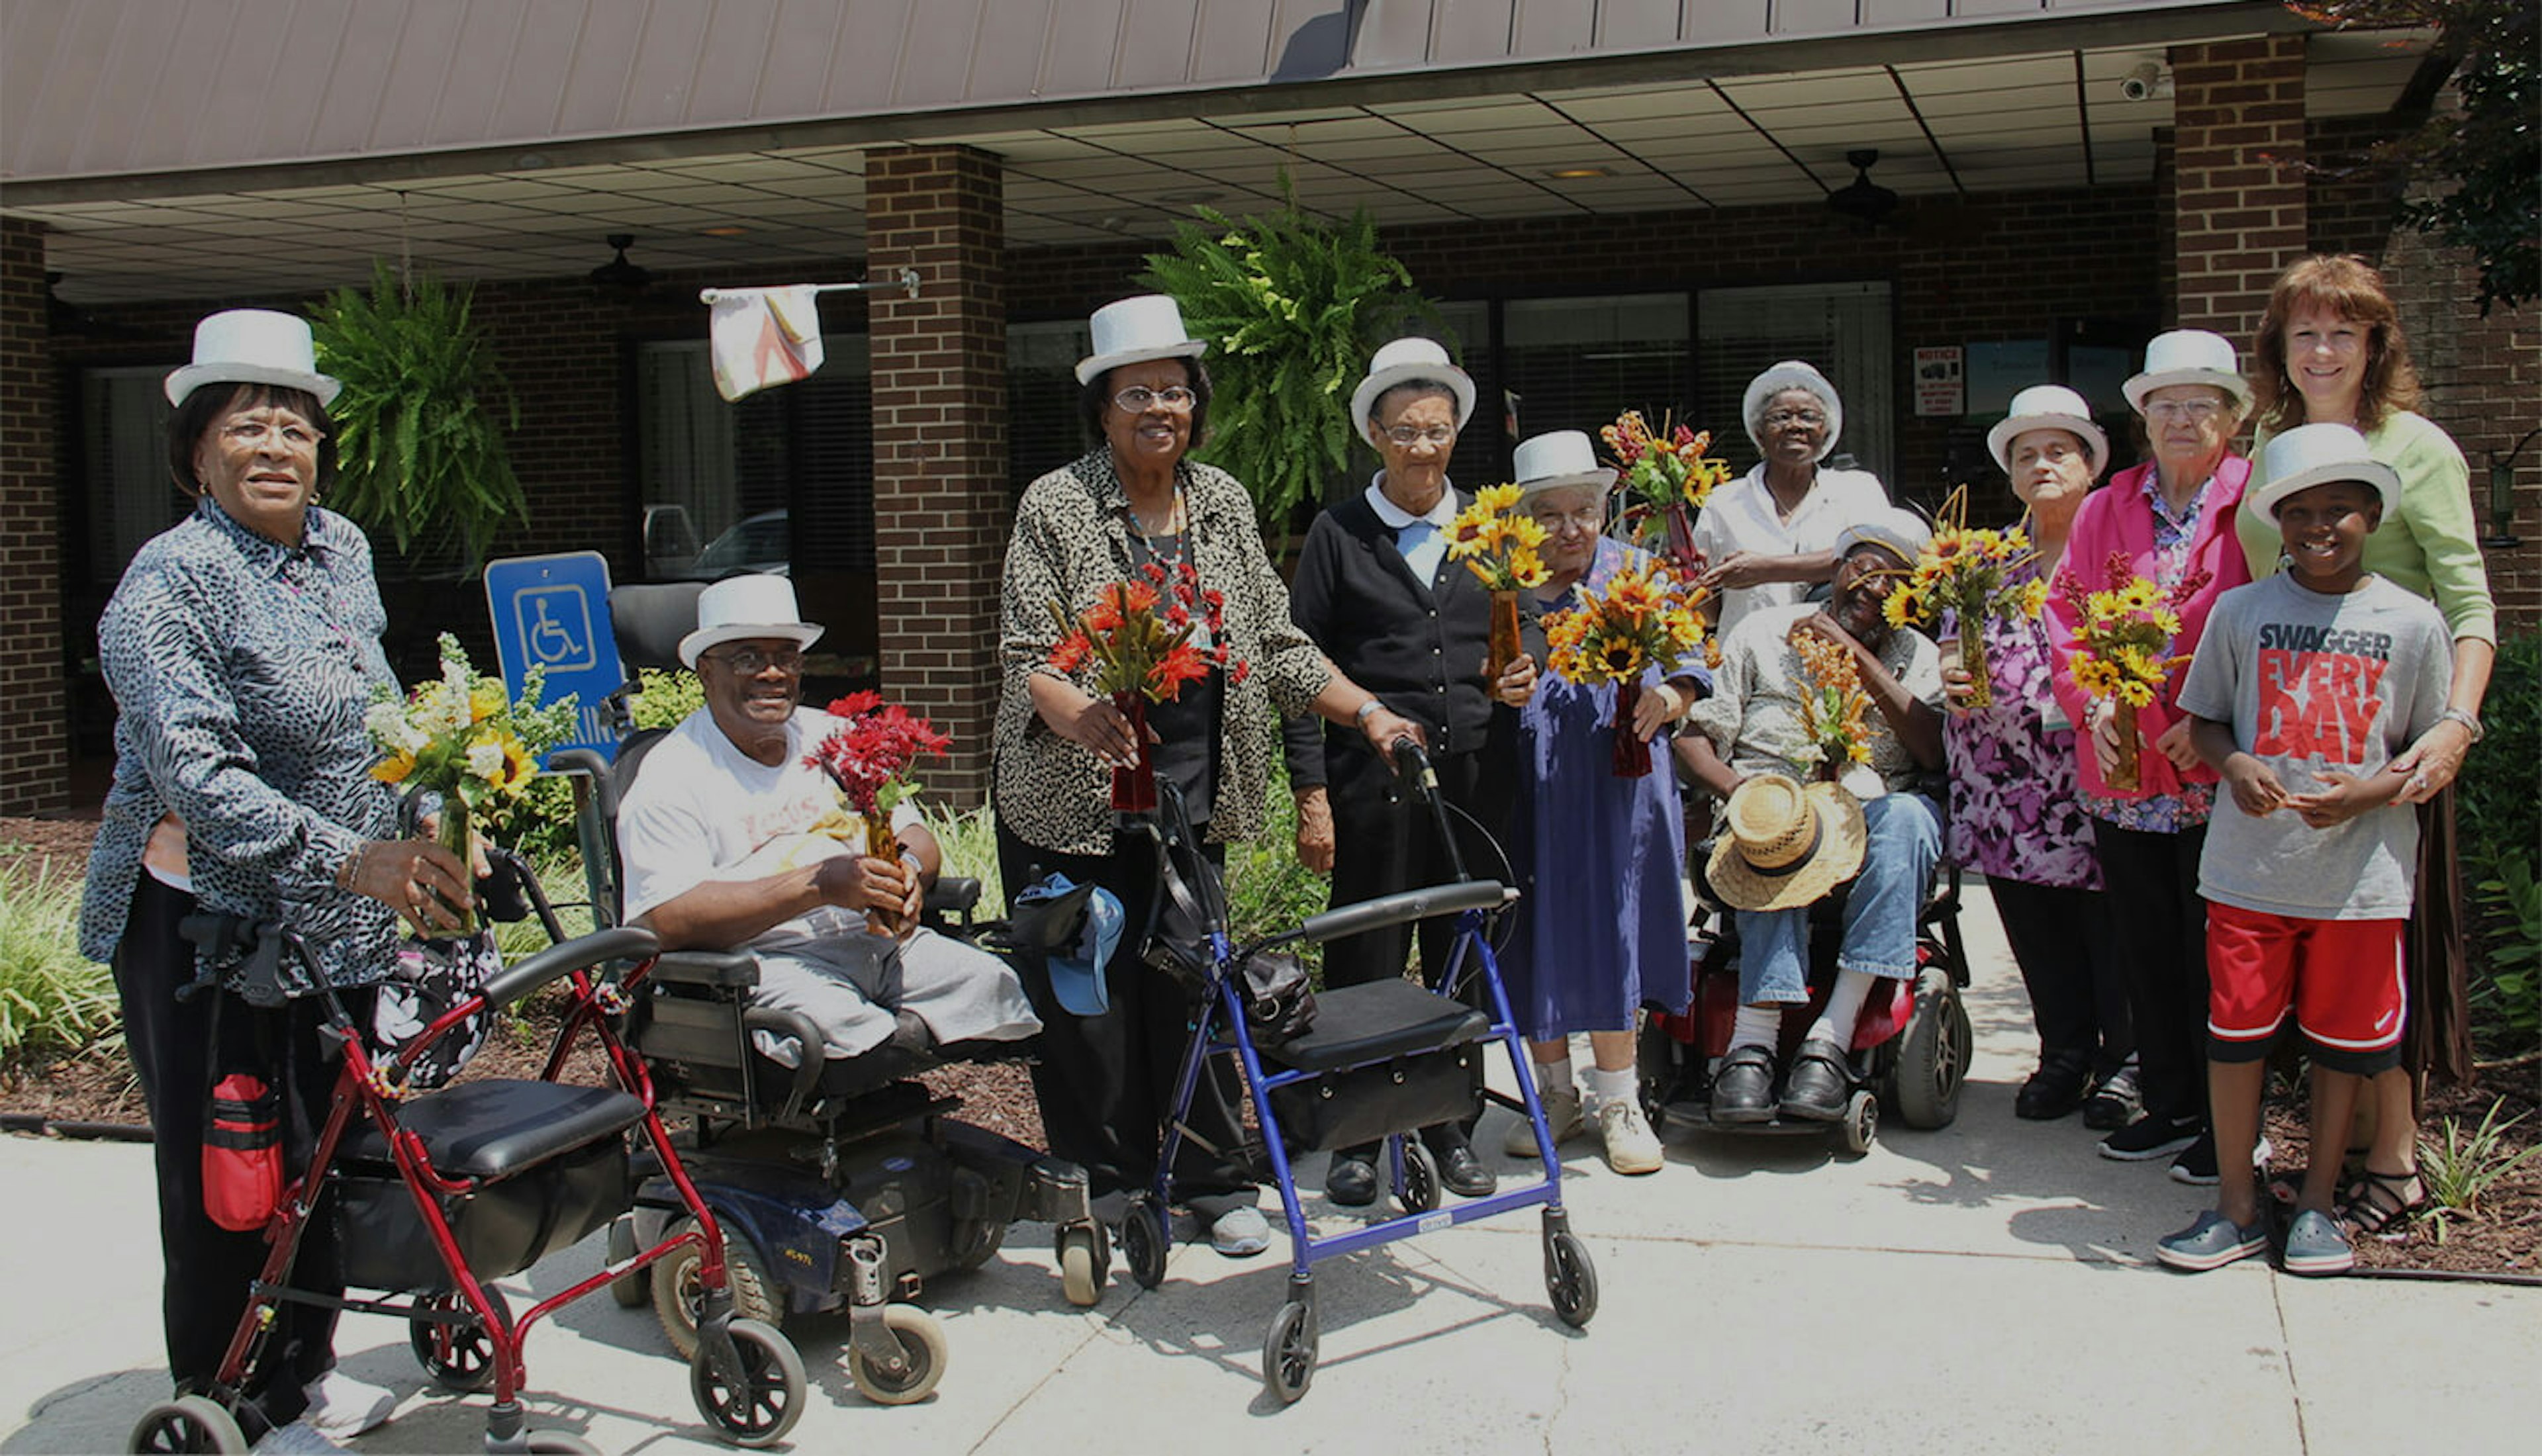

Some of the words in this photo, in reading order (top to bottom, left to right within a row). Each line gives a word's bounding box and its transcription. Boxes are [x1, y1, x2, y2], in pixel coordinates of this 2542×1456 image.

[1918, 349, 1958, 360] NOTICE
[2259, 623, 2392, 661] SWAGGER
[2258, 649, 2389, 700] EVERY
[2254, 690, 2384, 764] DAY
